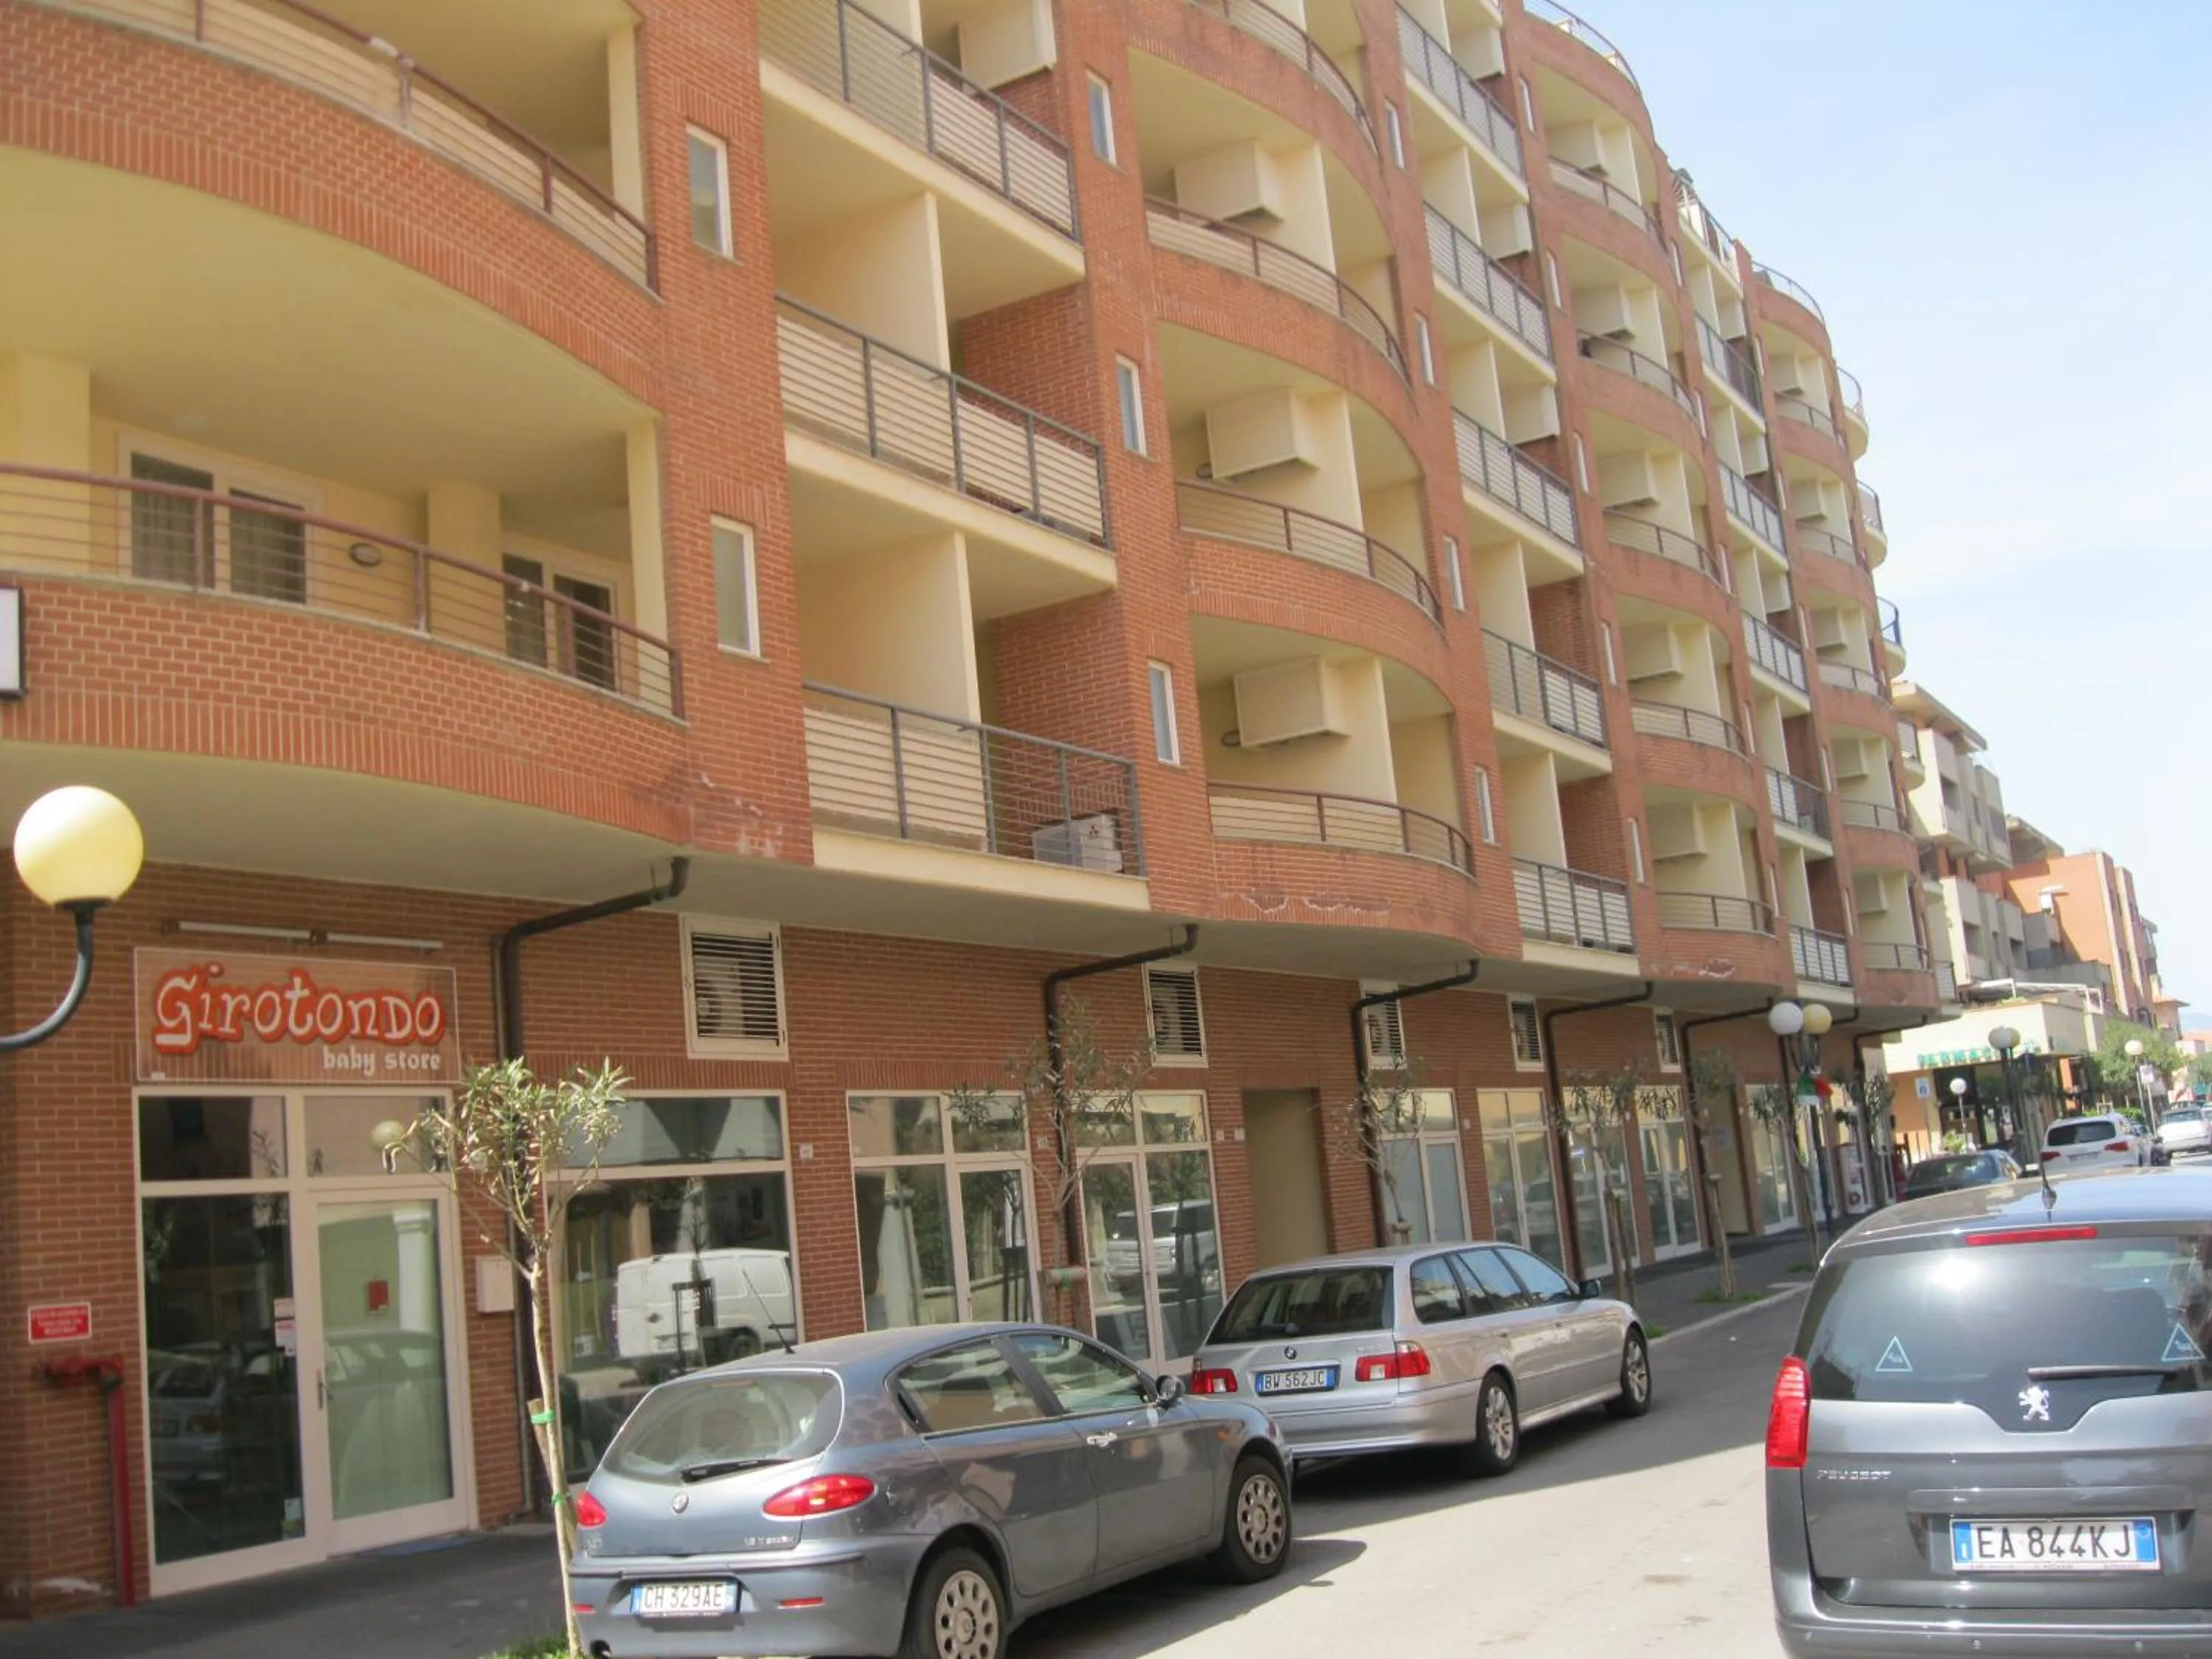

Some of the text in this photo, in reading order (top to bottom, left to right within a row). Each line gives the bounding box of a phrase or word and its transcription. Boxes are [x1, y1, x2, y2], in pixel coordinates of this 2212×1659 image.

[323, 1046, 442, 1076] baby store
[1264, 1374, 1281, 1390] BW
[1285, 1370, 1326, 1388] 562JC
[1977, 1526, 2016, 1559] EA
[2027, 1524, 2131, 1558] 844KJ
[643, 1583, 723, 1609] CH 329AE
